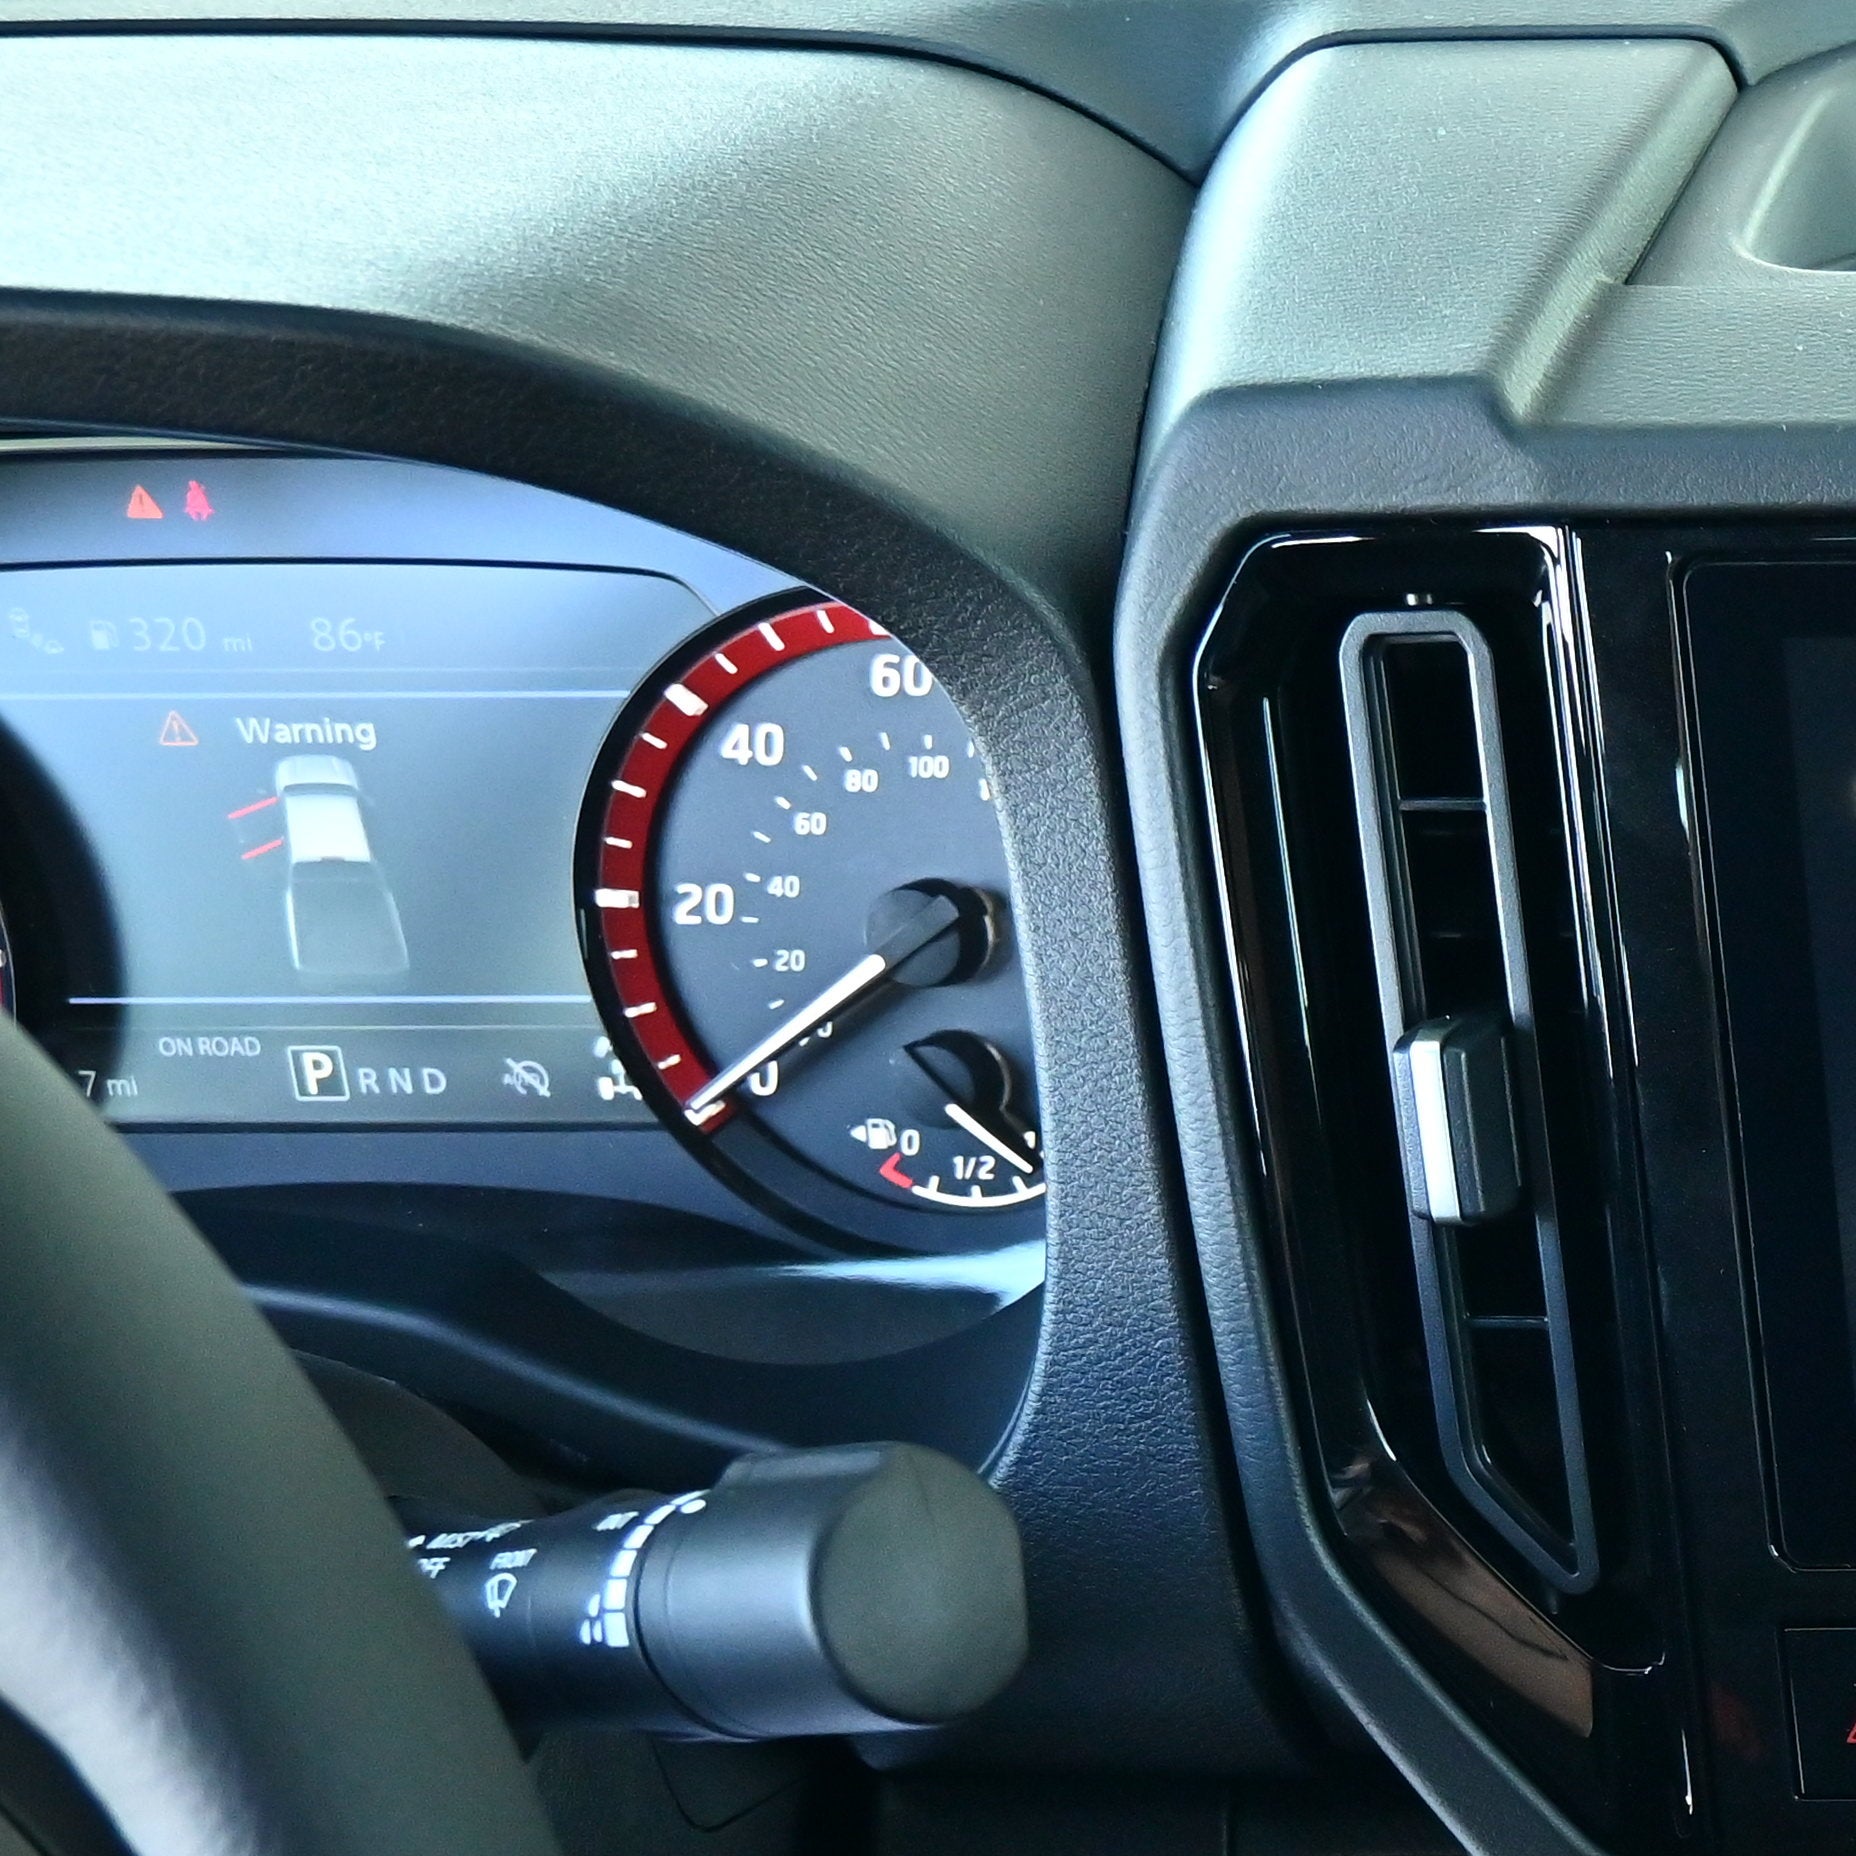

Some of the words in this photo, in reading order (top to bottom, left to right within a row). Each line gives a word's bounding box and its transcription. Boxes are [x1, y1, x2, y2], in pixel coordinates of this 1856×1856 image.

[128, 616, 207, 653] 320
[223, 633, 253, 653] mi
[869, 653, 934, 698] 60
[236, 716, 377, 751] Warning
[719, 722, 785, 766] 40
[909, 755, 950, 779] 100
[844, 769, 879, 793] 80
[793, 812, 827, 836] 60
[766, 875, 801, 898] 40
[672, 882, 735, 926] 20
[773, 949, 806, 972] 20
[158, 1036, 196, 1057] ON
[198, 1036, 262, 1057] ROAD
[304, 1051, 333, 1095] P
[359, 1067, 379, 1094] R
[391, 1068, 412, 1094] N
[425, 1069, 446, 1095] D
[107, 1076, 138, 1097] mi
[901, 1129, 921, 1156] 0
[952, 1155, 996, 1181] 1/2
